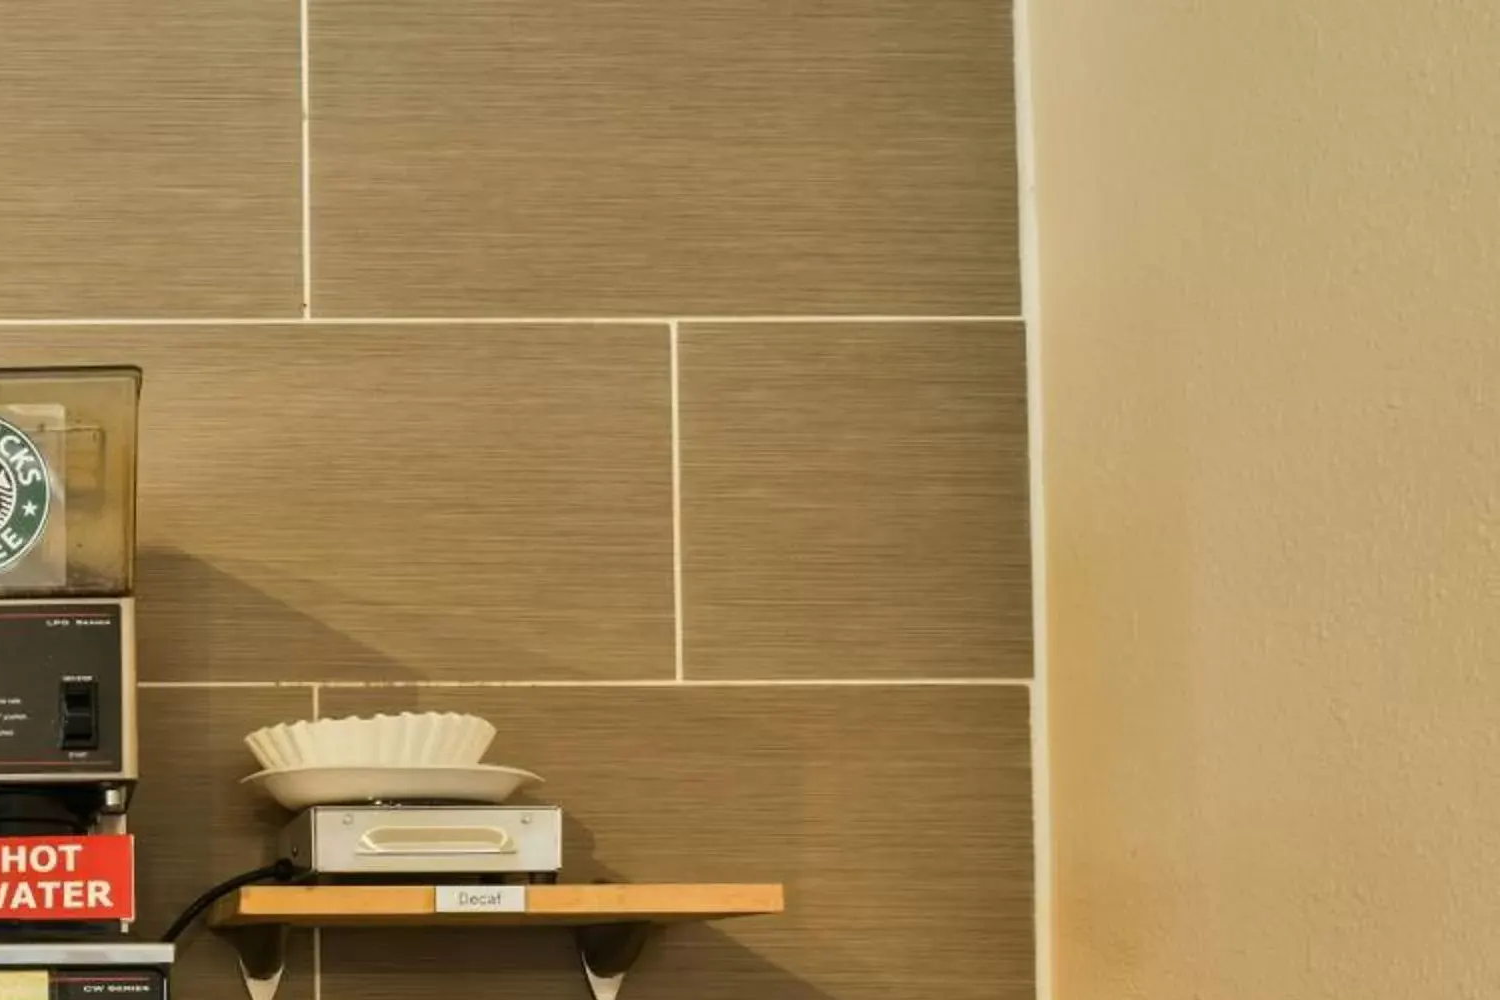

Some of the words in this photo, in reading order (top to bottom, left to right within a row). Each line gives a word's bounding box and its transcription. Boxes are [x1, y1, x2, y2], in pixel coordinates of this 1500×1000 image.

[0, 844, 84, 873] HOT
[459, 891, 502, 906] Decaf
[83, 984, 105, 993] CW
